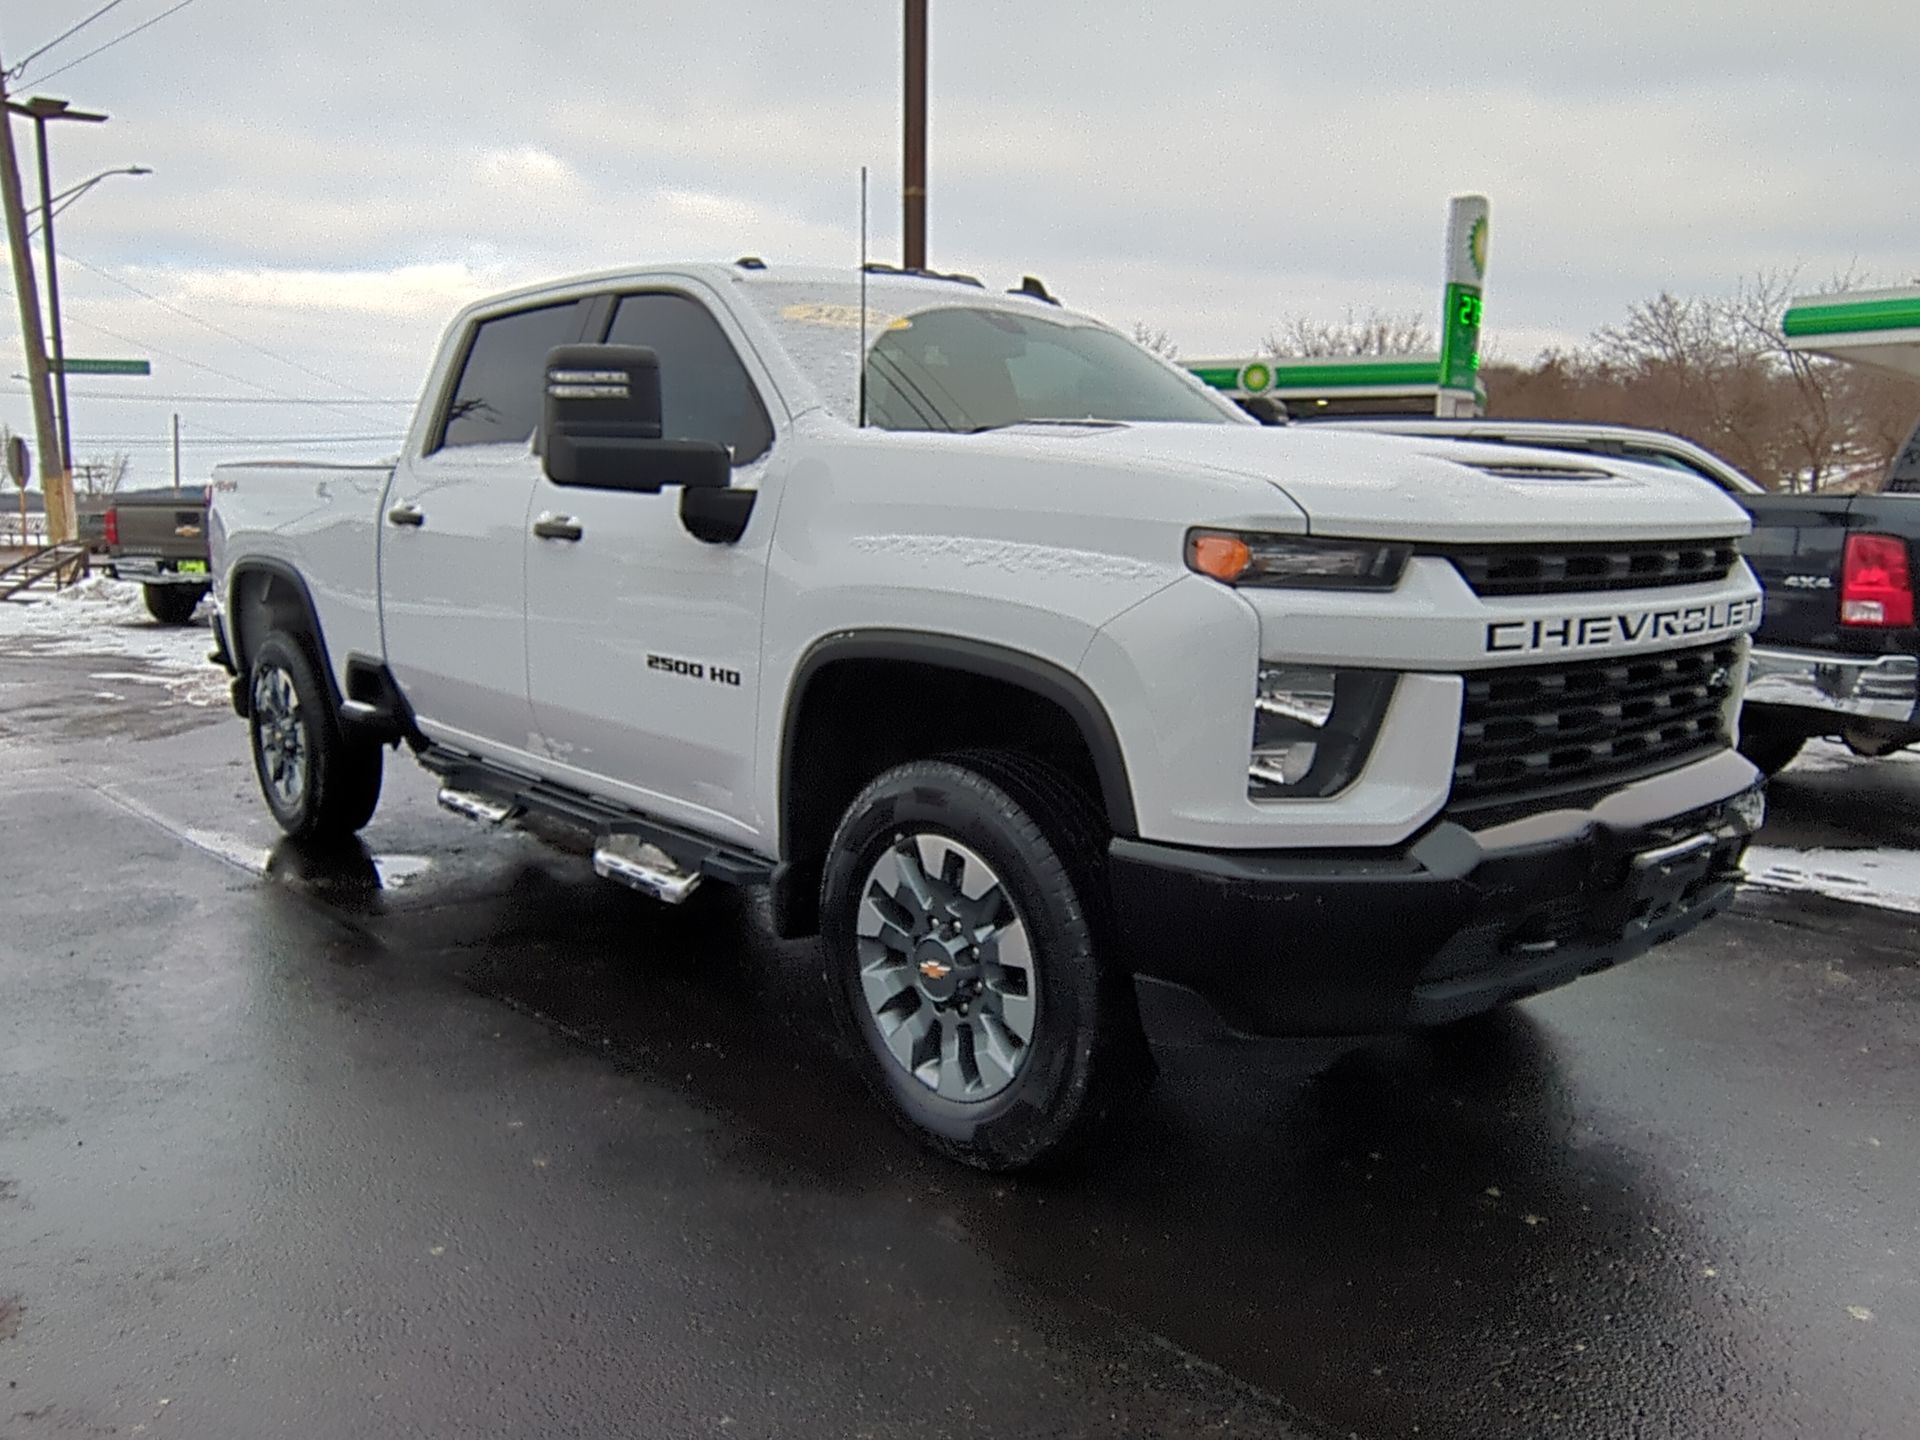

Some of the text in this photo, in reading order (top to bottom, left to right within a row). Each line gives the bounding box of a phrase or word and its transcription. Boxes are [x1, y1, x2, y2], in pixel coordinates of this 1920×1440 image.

[1486, 599, 1759, 652] CHEVROLET
[646, 653, 741, 686] 2500 HD
